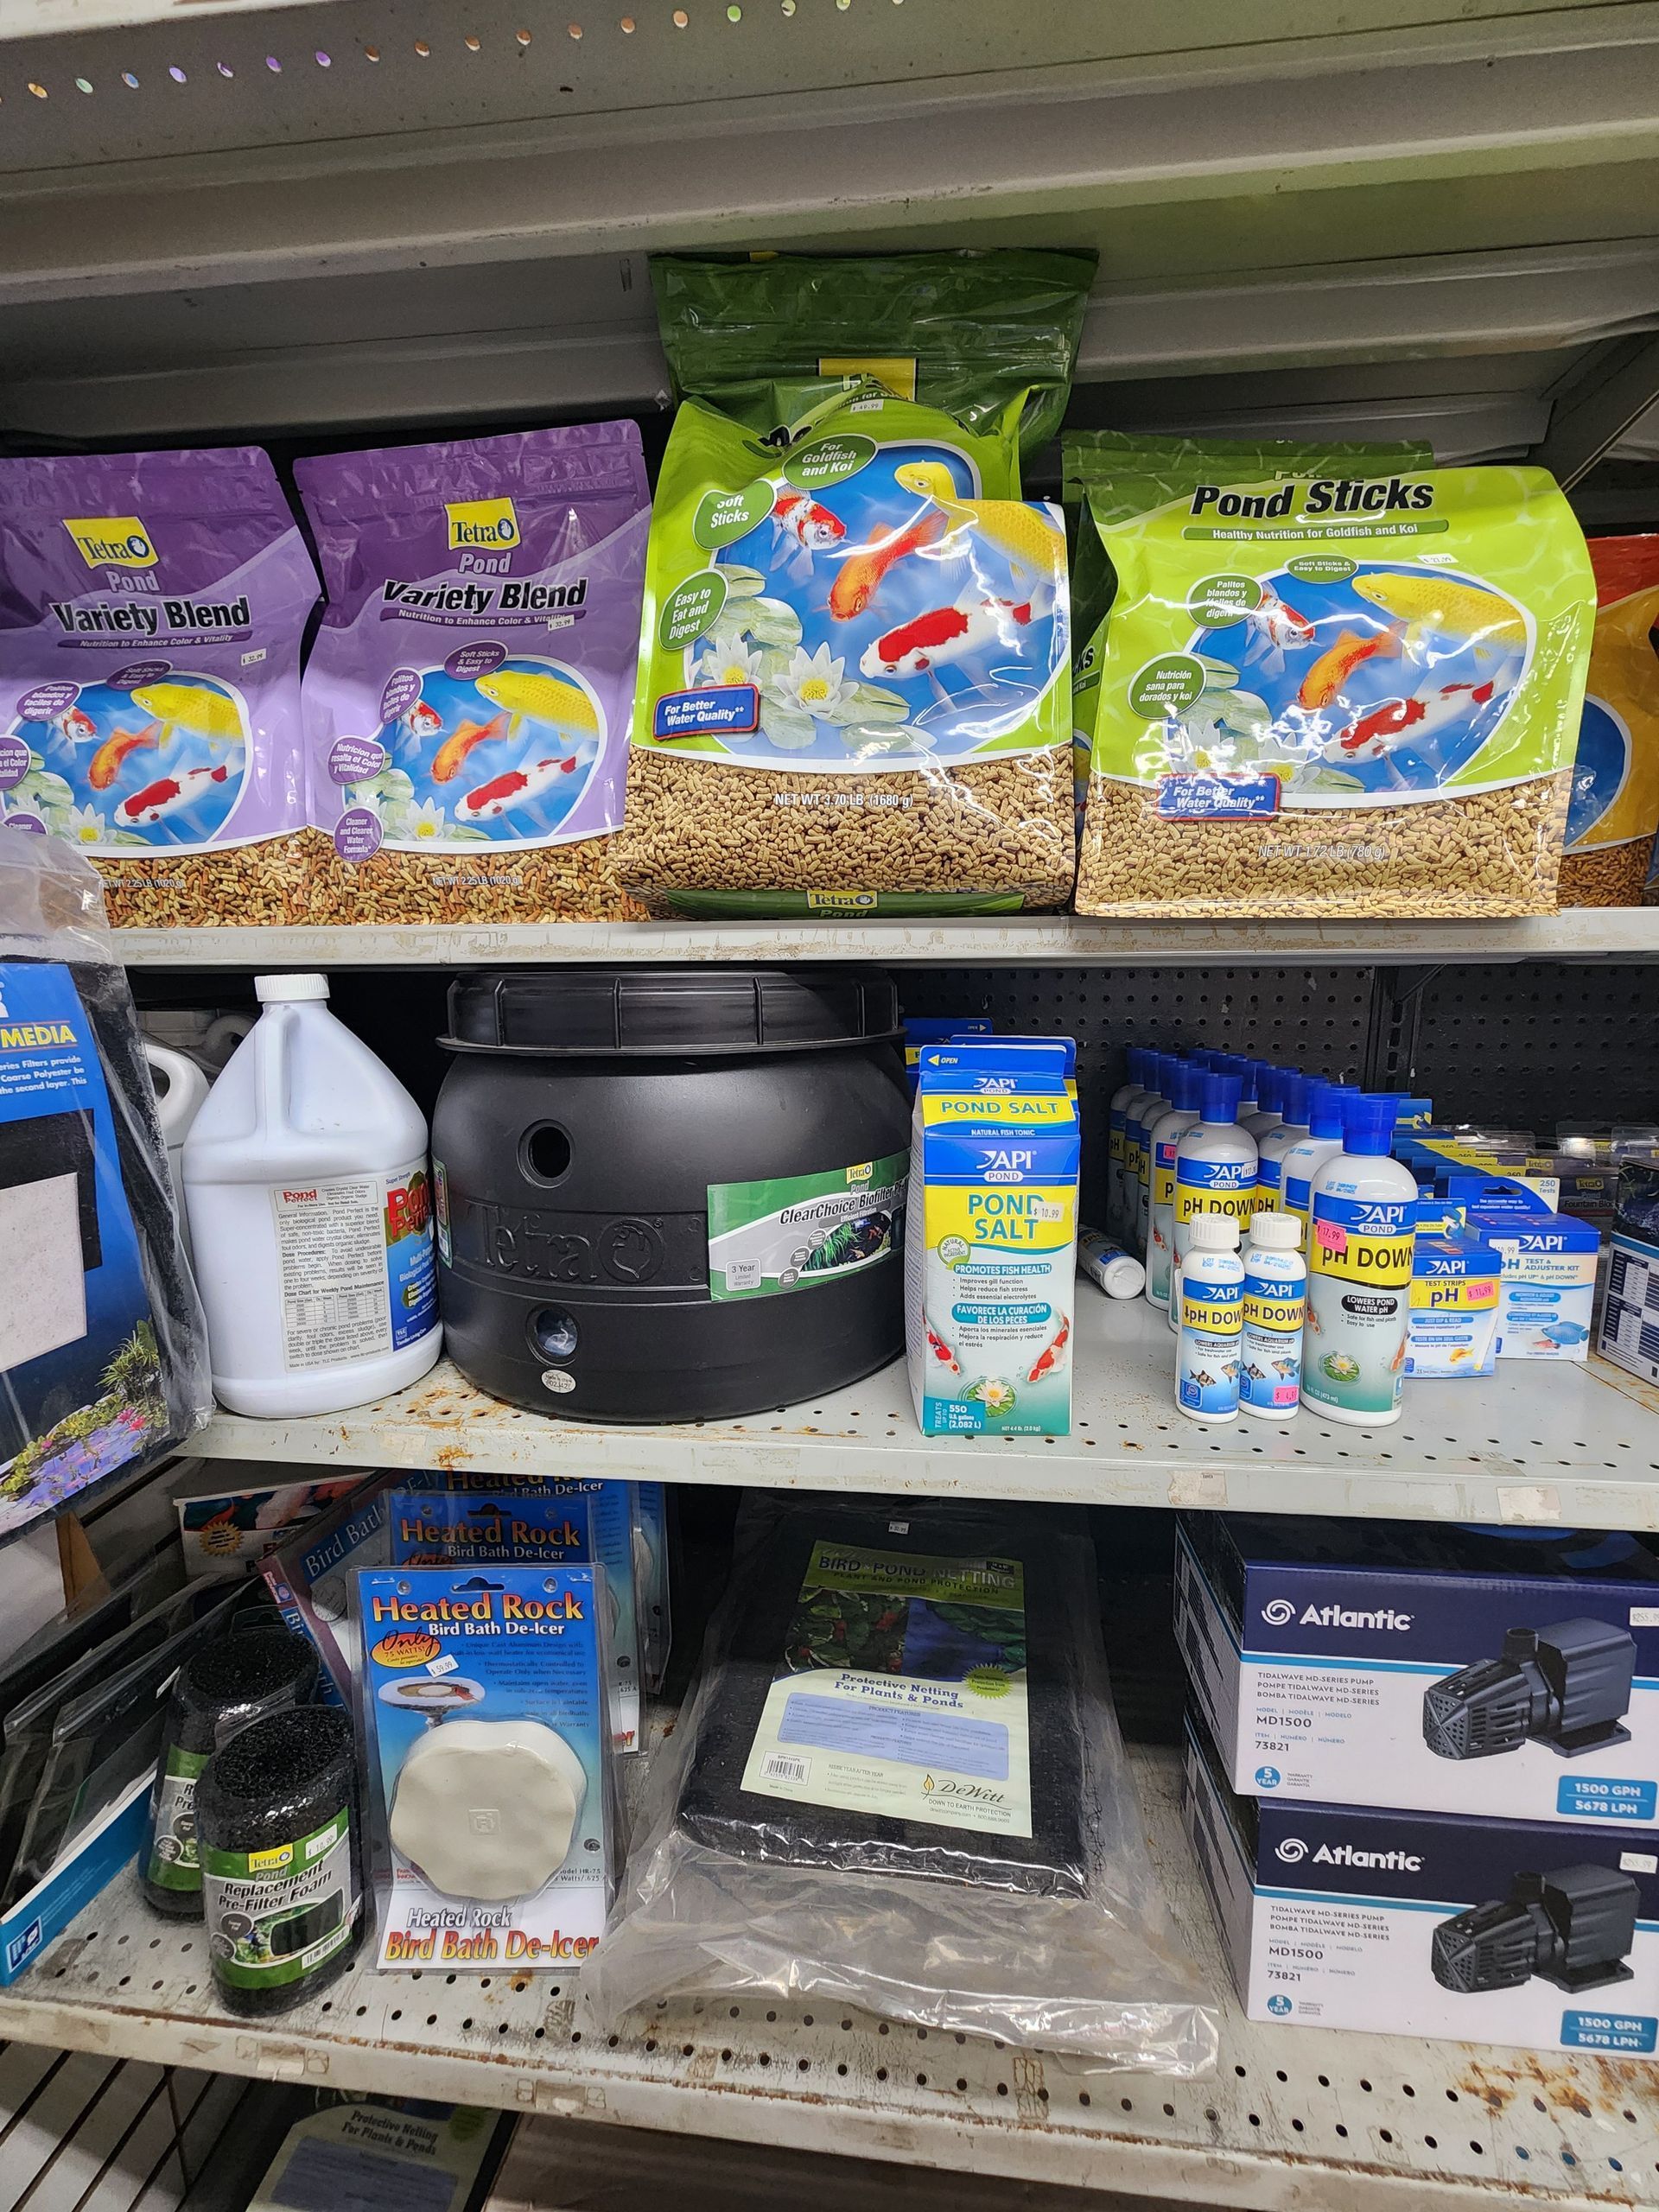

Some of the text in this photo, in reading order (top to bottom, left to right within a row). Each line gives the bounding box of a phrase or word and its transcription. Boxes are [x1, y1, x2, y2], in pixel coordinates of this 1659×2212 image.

[802, 450, 857, 463] Goldfish
[802, 461, 854, 476] and Koi
[1190, 478, 1435, 520] Pond Sticks
[710, 509, 749, 528] Sticks
[452, 522, 498, 543] Tetra
[1213, 524, 1418, 541] Healthy Nutrition for Goldfish and Koi
[459, 552, 512, 574] Pond
[106, 570, 160, 592] Pond
[383, 577, 588, 615] Variety Blend
[675, 588, 711, 607] Easy to
[49, 594, 250, 636] Variety Blend
[672, 601, 709, 624] Eat and
[669, 619, 701, 639] Digest
[132, 639, 168, 647] Enhance
[170, 637, 192, 645] Color
[203, 633, 233, 643] Vitality
[1156, 671, 1192, 679] Nutrición
[1166, 683, 1185, 691] para
[664, 700, 716, 715] For Better
[774, 794, 913, 807] NET WT 3.70 LB (1680 g)
[810, 893, 855, 906] Tetra
[1, 1026, 77, 1048] MEDIA
[50, 1056, 82, 1066] provide
[1, 1073, 32, 1083] Coarse
[33, 1069, 72, 1079] Polyester
[941, 1102, 1058, 1114] POND SALT
[283, 1189, 317, 1200] Pond
[779, 1186, 893, 1226] ClearChoice Biofilter
[1041, 1208, 1059, 1218] 10.99
[1369, 1205, 1404, 1223] API
[976, 1219, 1039, 1239] SALT
[1322, 1246, 1413, 1268] pH DOWN
[739, 1264, 755, 1273] Year
[955, 1264, 1051, 1274] PROMOTES FISH HEALTH
[1347, 1297, 1376, 1306] LOWERS
[1431, 1288, 1459, 1306] pH
[957, 1306, 996, 1315] FAVORECE
[1008, 1304, 1047, 1315] CURACIÓN
[1378, 1306, 1389, 1315] pH
[401, 1517, 580, 1546] Heated Rock
[448, 1546, 564, 1560] Bird Bath De-Icer
[818, 1556, 1016, 1588] BIRD POND NETTING
[834, 1572, 866, 1580] PLANT
[931, 1579, 999, 1595] PROTECTION
[372, 1592, 584, 1622] Heated Rock
[1300, 1604, 1412, 1630] Atlantic
[429, 1621, 565, 1636] Bird Bath De-Icer
[382, 1627, 435, 1656] Only
[397, 1647, 424, 1656] WATTS!
[1258, 1672, 1304, 1681] TIDALWAVE
[1306, 1675, 1349, 1684] MD-SERIES
[841, 1673, 906, 1690] Protective
[910, 1684, 959, 1700] Netting
[834, 1681, 963, 1708] For Plants & Ponds
[1288, 1694, 1334, 1702] TIDALWAVE
[1337, 1697, 1380, 1706] MD-SERIES
[1256, 1716, 1312, 1728] MD1500
[1255, 1740, 1289, 1751] 73821
[1264, 1768, 1273, 1777] 5
[938, 1779, 1006, 1803] DeWitt
[1574, 1783, 1641, 1797] 1500 GPH
[976, 1806, 1011, 1817] PROTECTION
[1575, 1801, 1637, 1814] 5678 LPH
[1313, 1843, 1421, 1872] Atlantic
[225, 1859, 324, 1898] Replacement
[219, 1871, 333, 1910] Pre-Filter Foam
[407, 1905, 513, 1928] Heated Rock
[1269, 1923, 1390, 1941] BOMBA TIDALWAVE MD-SERIES
[1300, 1917, 1345, 1928] TIDALWAVE
[1347, 1923, 1389, 1932] MD-SERIES
[385, 1929, 600, 1960] Bird Bath De-Icer
[1268, 1947, 1324, 1960] MD1500
[1268, 1970, 1301, 1982] 73821
[1275, 1996, 1284, 2005] 5
